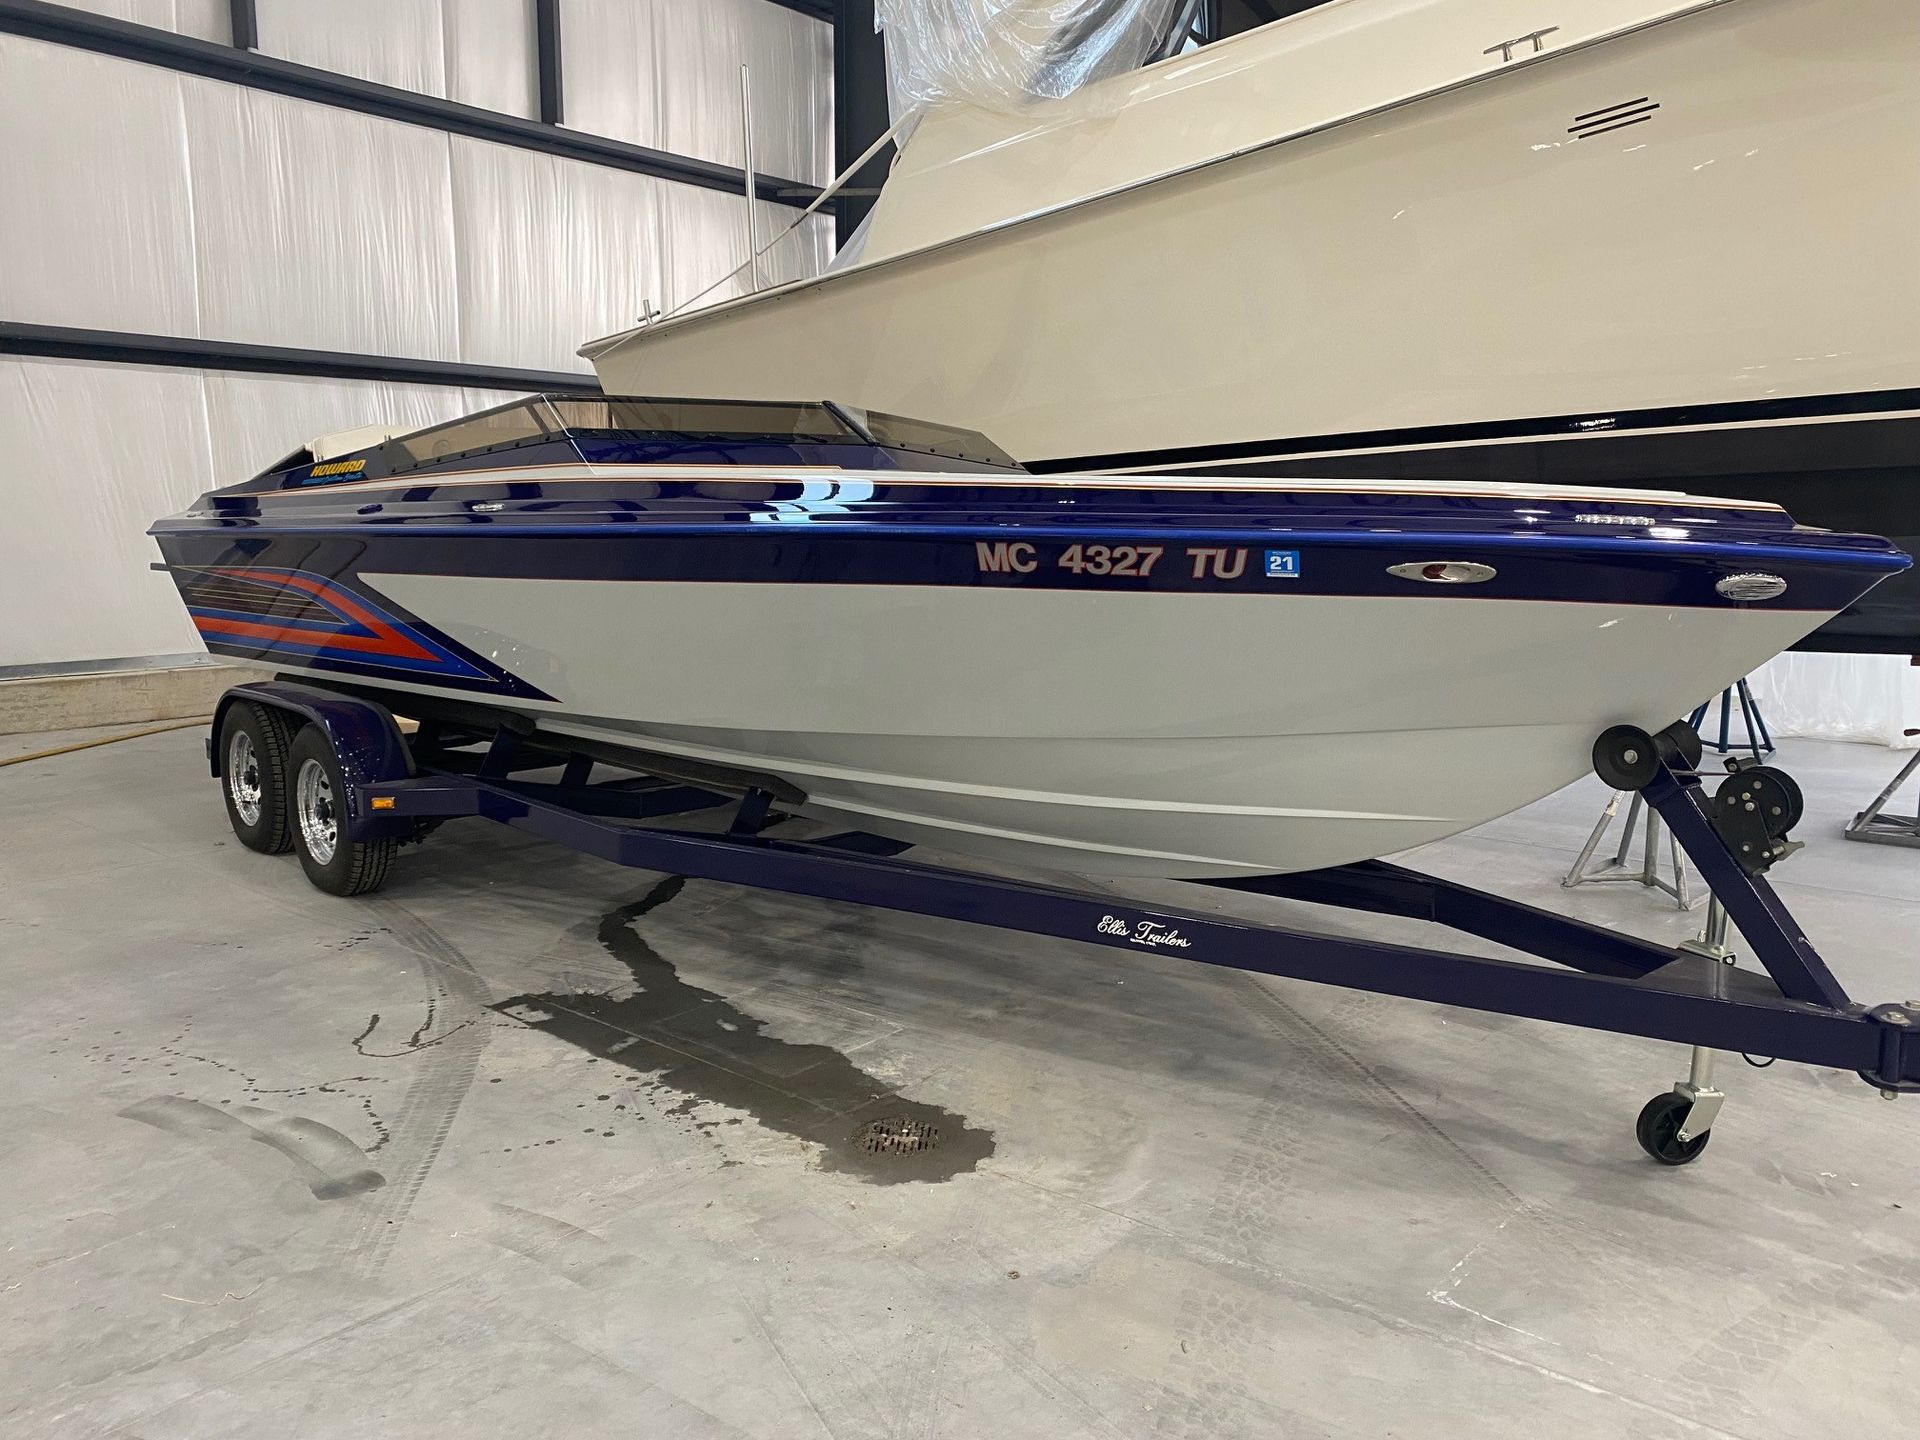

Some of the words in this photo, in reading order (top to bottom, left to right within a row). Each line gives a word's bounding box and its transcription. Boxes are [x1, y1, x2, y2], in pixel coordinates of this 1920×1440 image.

[310, 460, 366, 477] HOWARD
[976, 542, 1038, 573] MC
[1058, 544, 1164, 577] 4327
[1186, 548, 1248, 579] TU
[1270, 556, 1293, 570] 21
[1097, 915, 1130, 936] Ellis
[1135, 921, 1191, 947] Trailers
